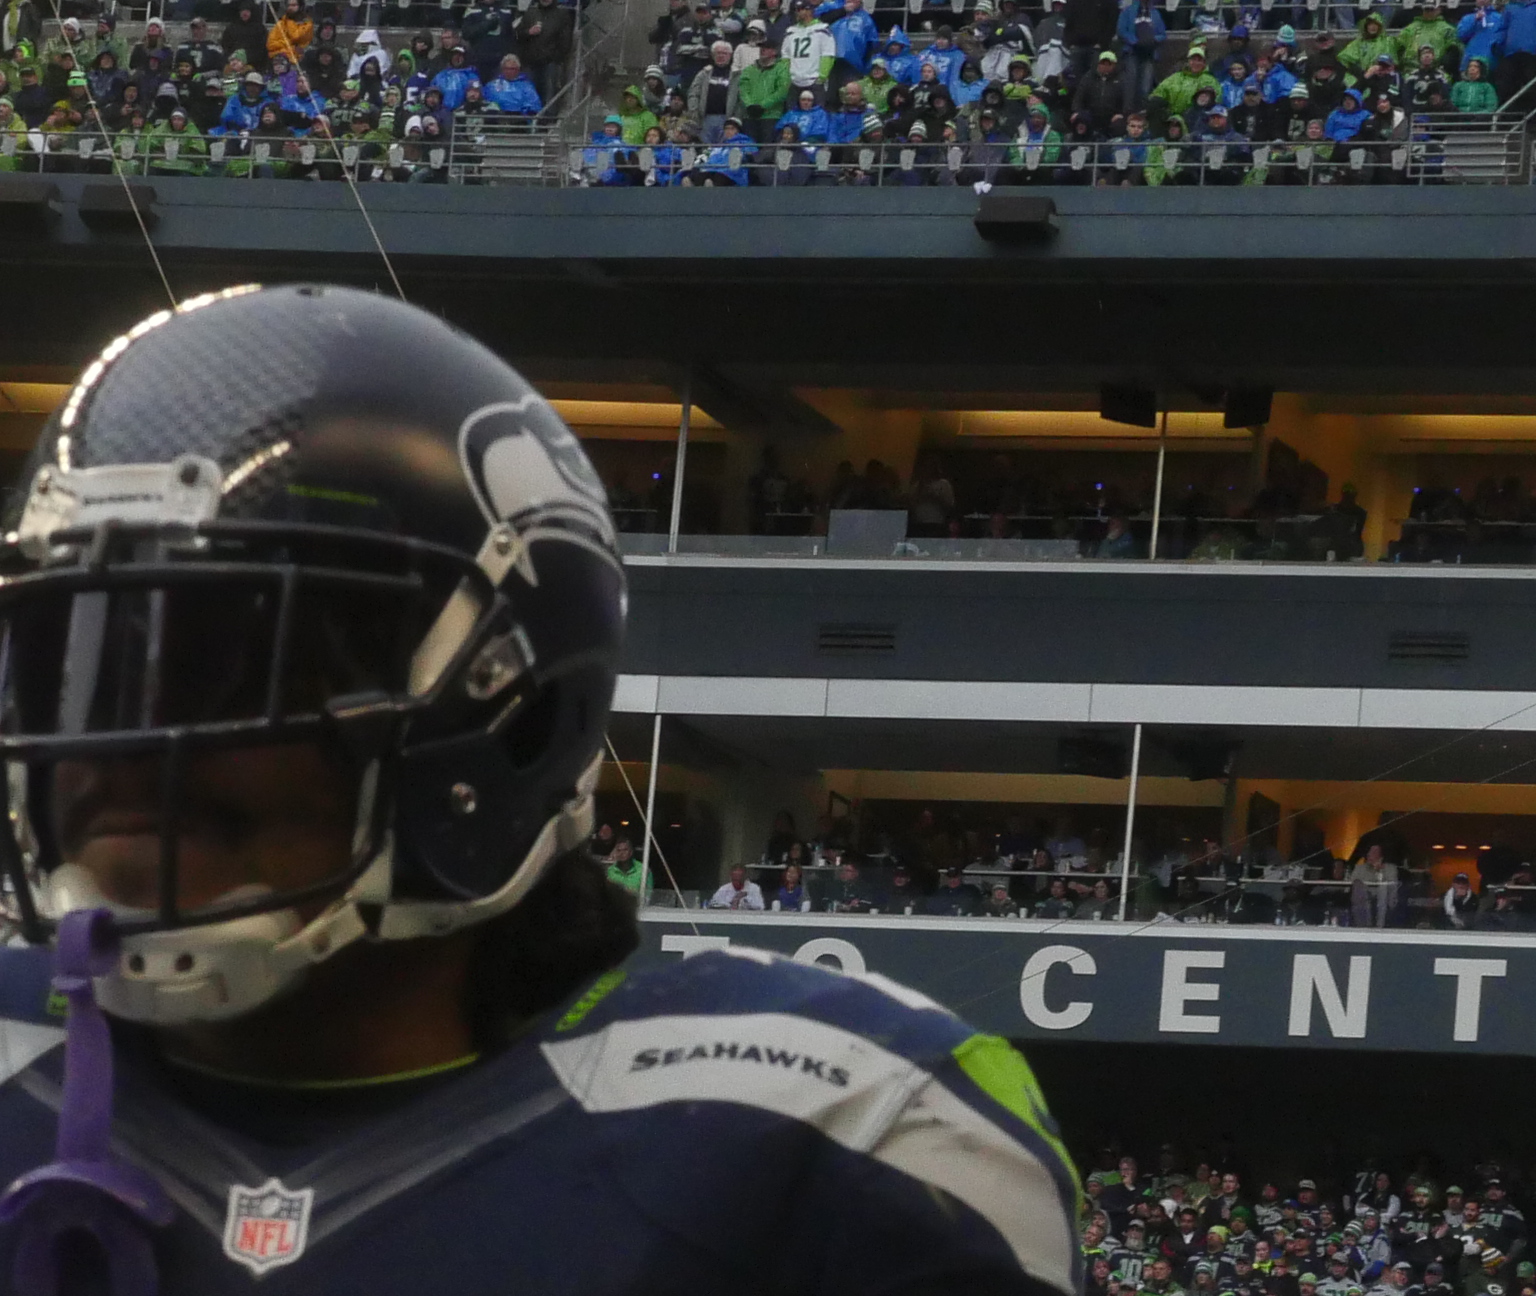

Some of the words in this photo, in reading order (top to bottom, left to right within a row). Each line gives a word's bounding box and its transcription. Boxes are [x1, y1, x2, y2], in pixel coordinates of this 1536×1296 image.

[792, 36, 812, 59] 12
[629, 1041, 851, 1089] SEAHAWKS
[237, 1218, 294, 1257] NFL
